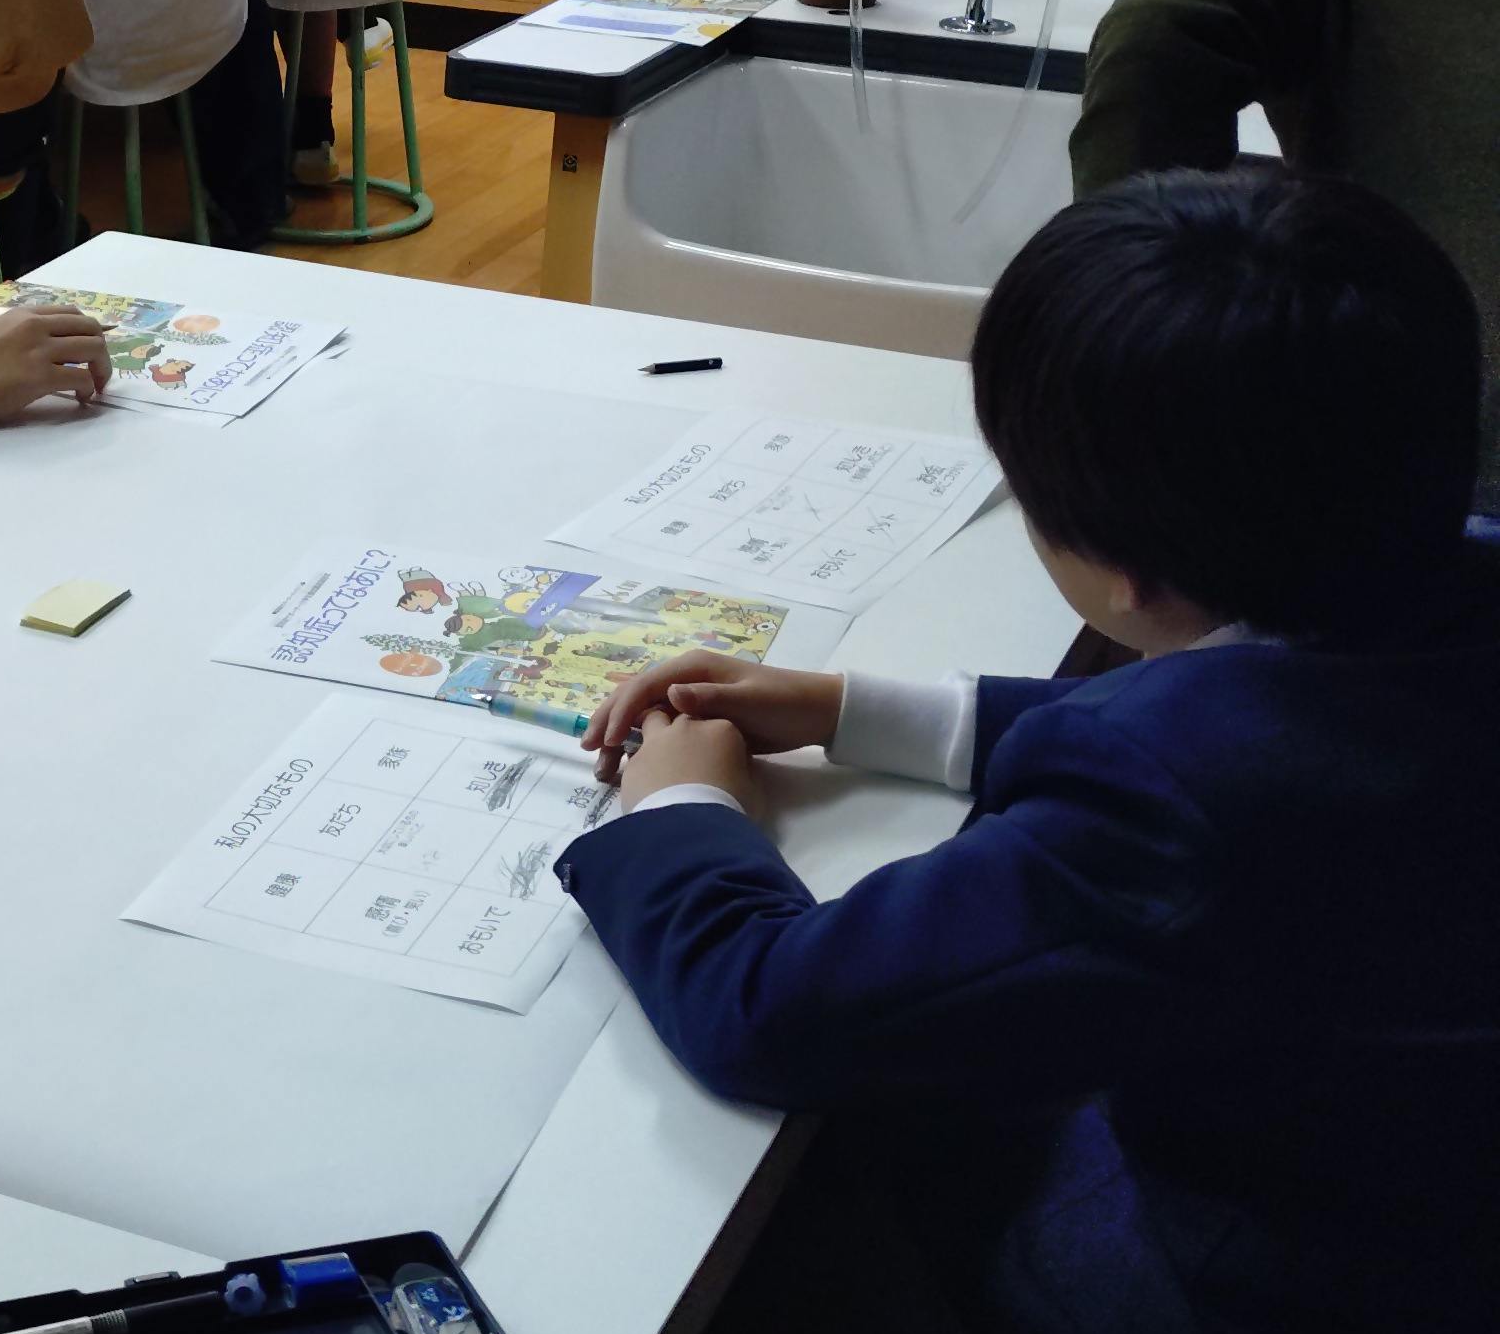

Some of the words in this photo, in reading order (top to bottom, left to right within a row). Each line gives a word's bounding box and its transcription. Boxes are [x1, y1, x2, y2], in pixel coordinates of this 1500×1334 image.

[271, 550, 396, 663] 認知症ってなあに？
[378, 746, 411, 770] 家族
[466, 761, 506, 793] 知しき
[214, 759, 313, 849] 私の大切なもの
[566, 786, 604, 808] お金
[318, 803, 361, 837] 友だち
[265, 873, 301, 897] 健康
[458, 906, 511, 954] おもいで
